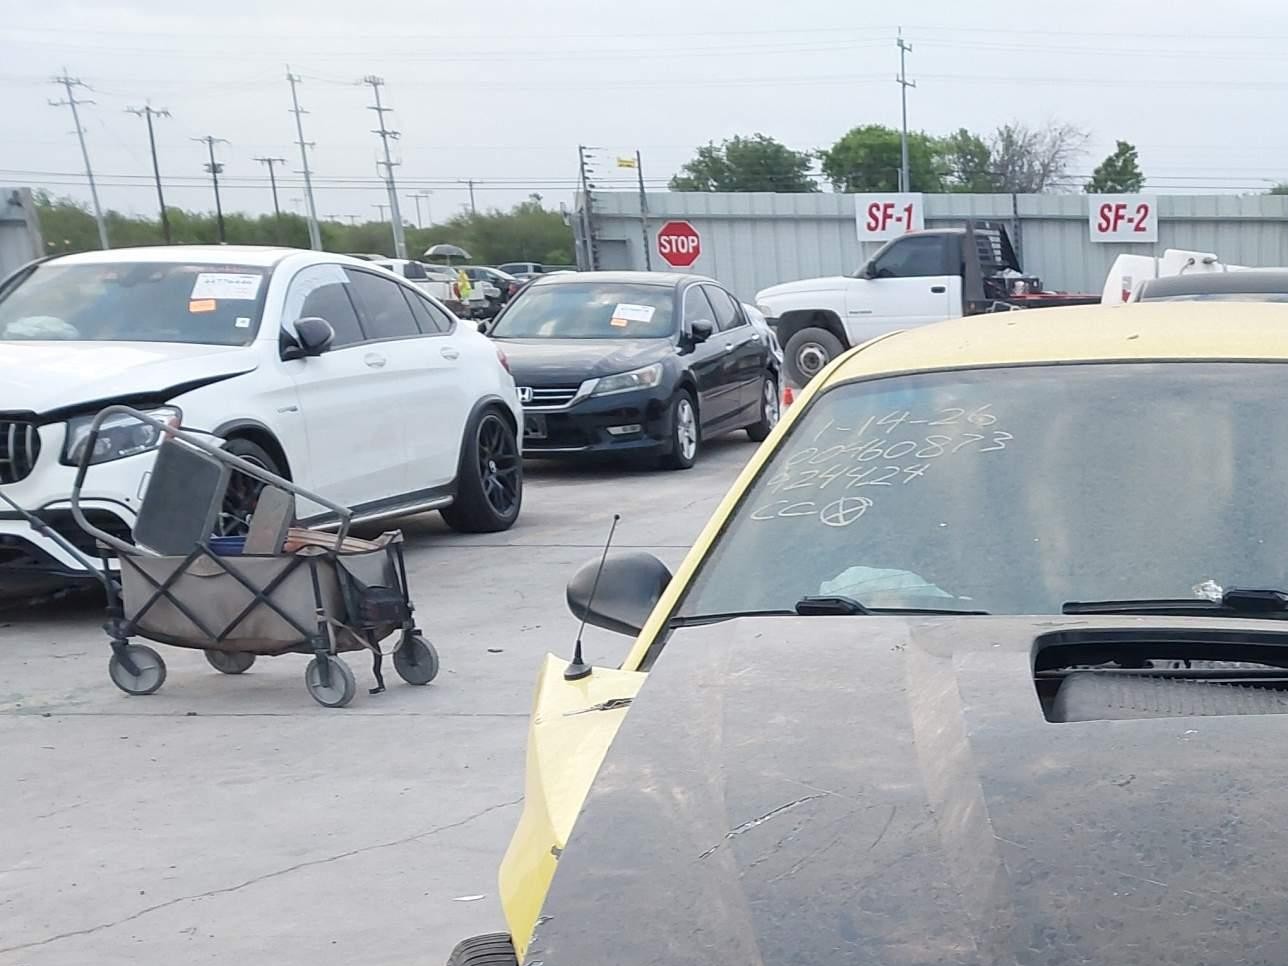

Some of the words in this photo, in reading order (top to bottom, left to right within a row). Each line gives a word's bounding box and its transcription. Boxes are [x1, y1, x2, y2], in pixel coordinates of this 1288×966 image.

[866, 202, 914, 232] SF-1
[1098, 203, 1150, 233] SF-2
[660, 235, 699, 254] STOP
